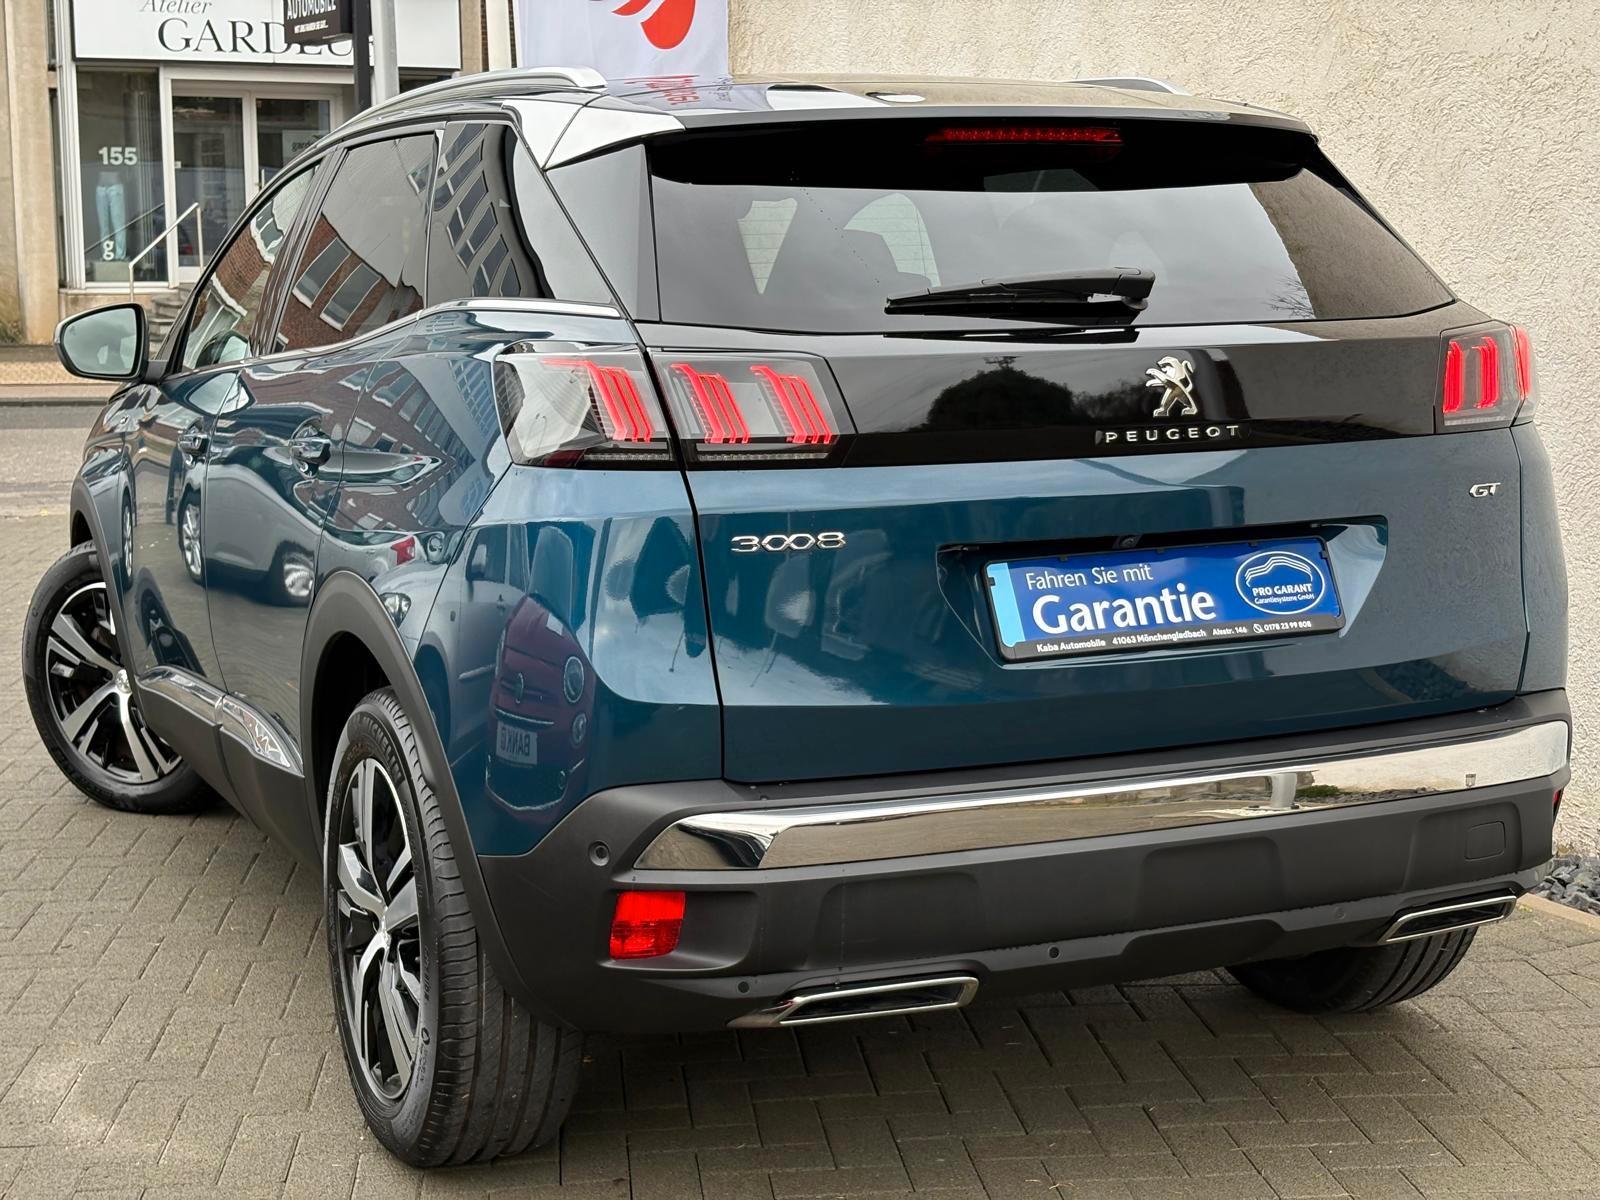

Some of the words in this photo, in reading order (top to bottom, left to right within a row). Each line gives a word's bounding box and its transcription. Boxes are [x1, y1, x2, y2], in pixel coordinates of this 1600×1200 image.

[139, 0, 212, 14] Atelier
[158, 18, 353, 56] GARD
[98, 146, 138, 165] 155
[1105, 425, 1239, 443] PEUGEOT
[1469, 482, 1501, 497] GT
[731, 532, 846, 552] 3008
[1026, 571, 1087, 590] Fahren
[1091, 566, 1118, 585] Sie
[1122, 564, 1154, 582] mit
[1252, 587, 1272, 597] PRO
[1273, 583, 1313, 595] GARANT
[1297, 593, 1315, 601] GmbH
[1032, 582, 1217, 634] Garantie
[1036, 643, 1059, 653] Kaba
[1060, 638, 1106, 651] Automobile
[1112, 635, 1137, 645] 41063
[1136, 629, 1207, 643] Mönchengladbach
[1264, 623, 1280, 632] 0178
